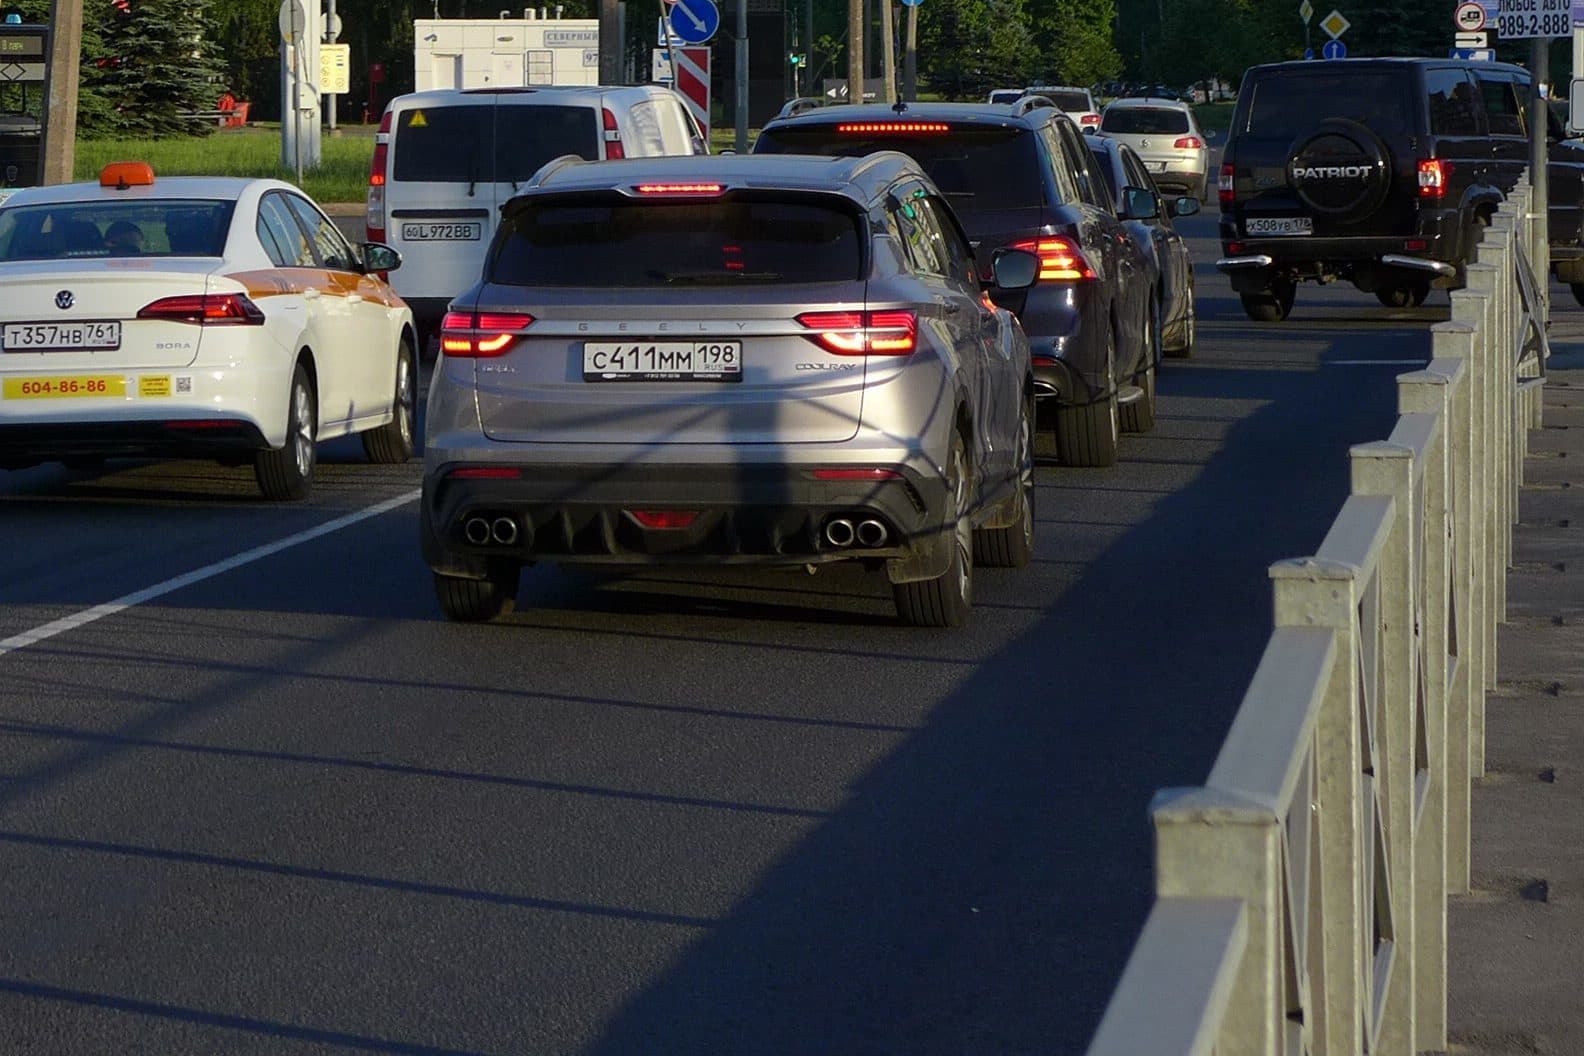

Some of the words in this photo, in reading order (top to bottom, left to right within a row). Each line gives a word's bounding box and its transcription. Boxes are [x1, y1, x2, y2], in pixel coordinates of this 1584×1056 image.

[1498, 14, 1569, 36] 989-2-888
[1293, 166, 1373, 179] PATRIOT
[87, 324, 115, 339] 761
[578, 323, 746, 331] GEELY
[697, 345, 734, 363] 198
[795, 362, 856, 371] COOLRAY
[22, 379, 106, 395] 604-86-86
